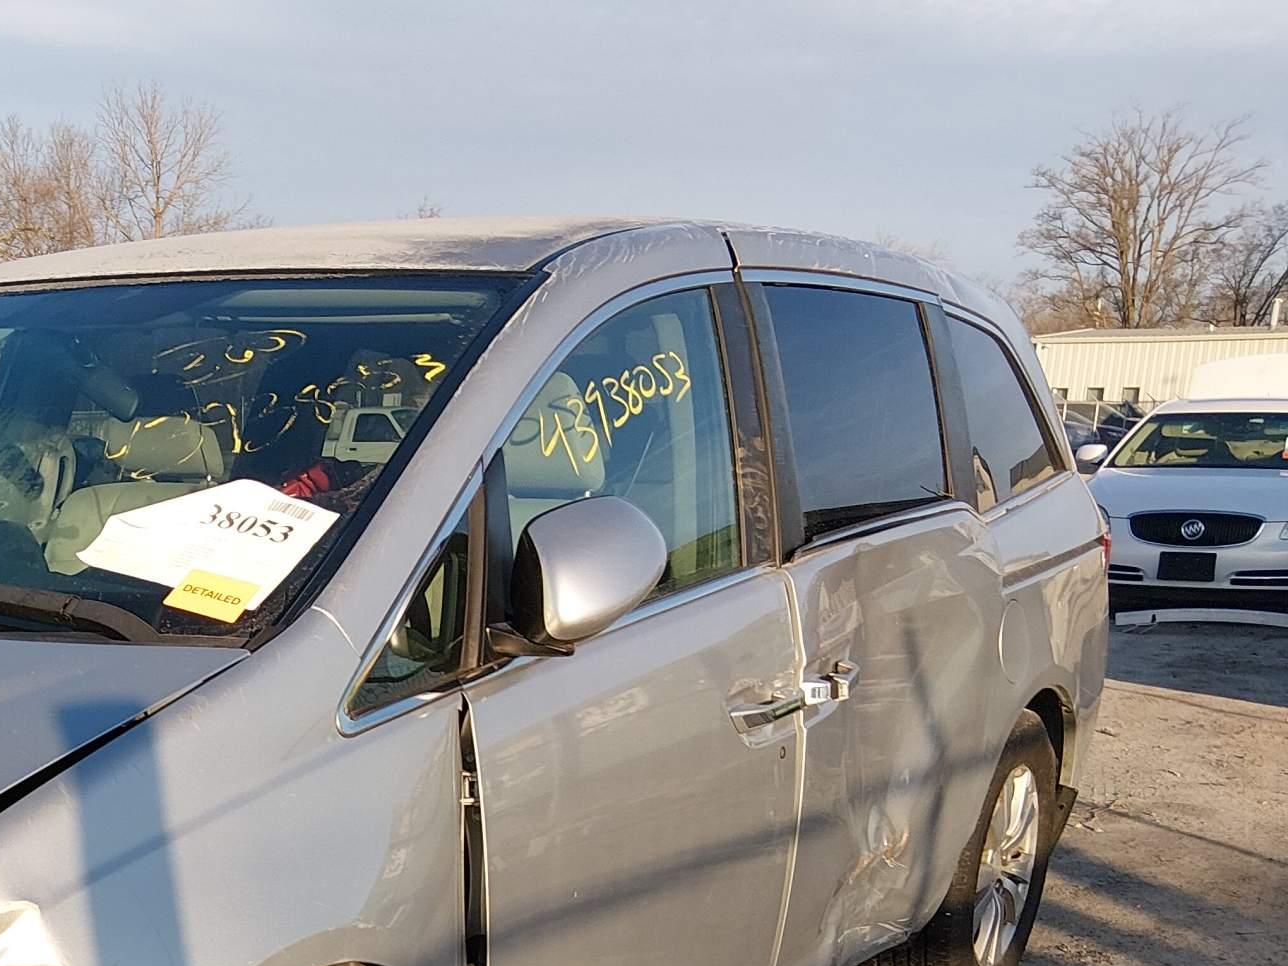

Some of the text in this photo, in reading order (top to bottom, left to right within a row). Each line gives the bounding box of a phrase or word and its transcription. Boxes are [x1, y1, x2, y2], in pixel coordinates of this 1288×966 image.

[539, 351, 691, 477] 43938053
[199, 503, 295, 543] 38053
[182, 584, 241, 606] DETAILED
